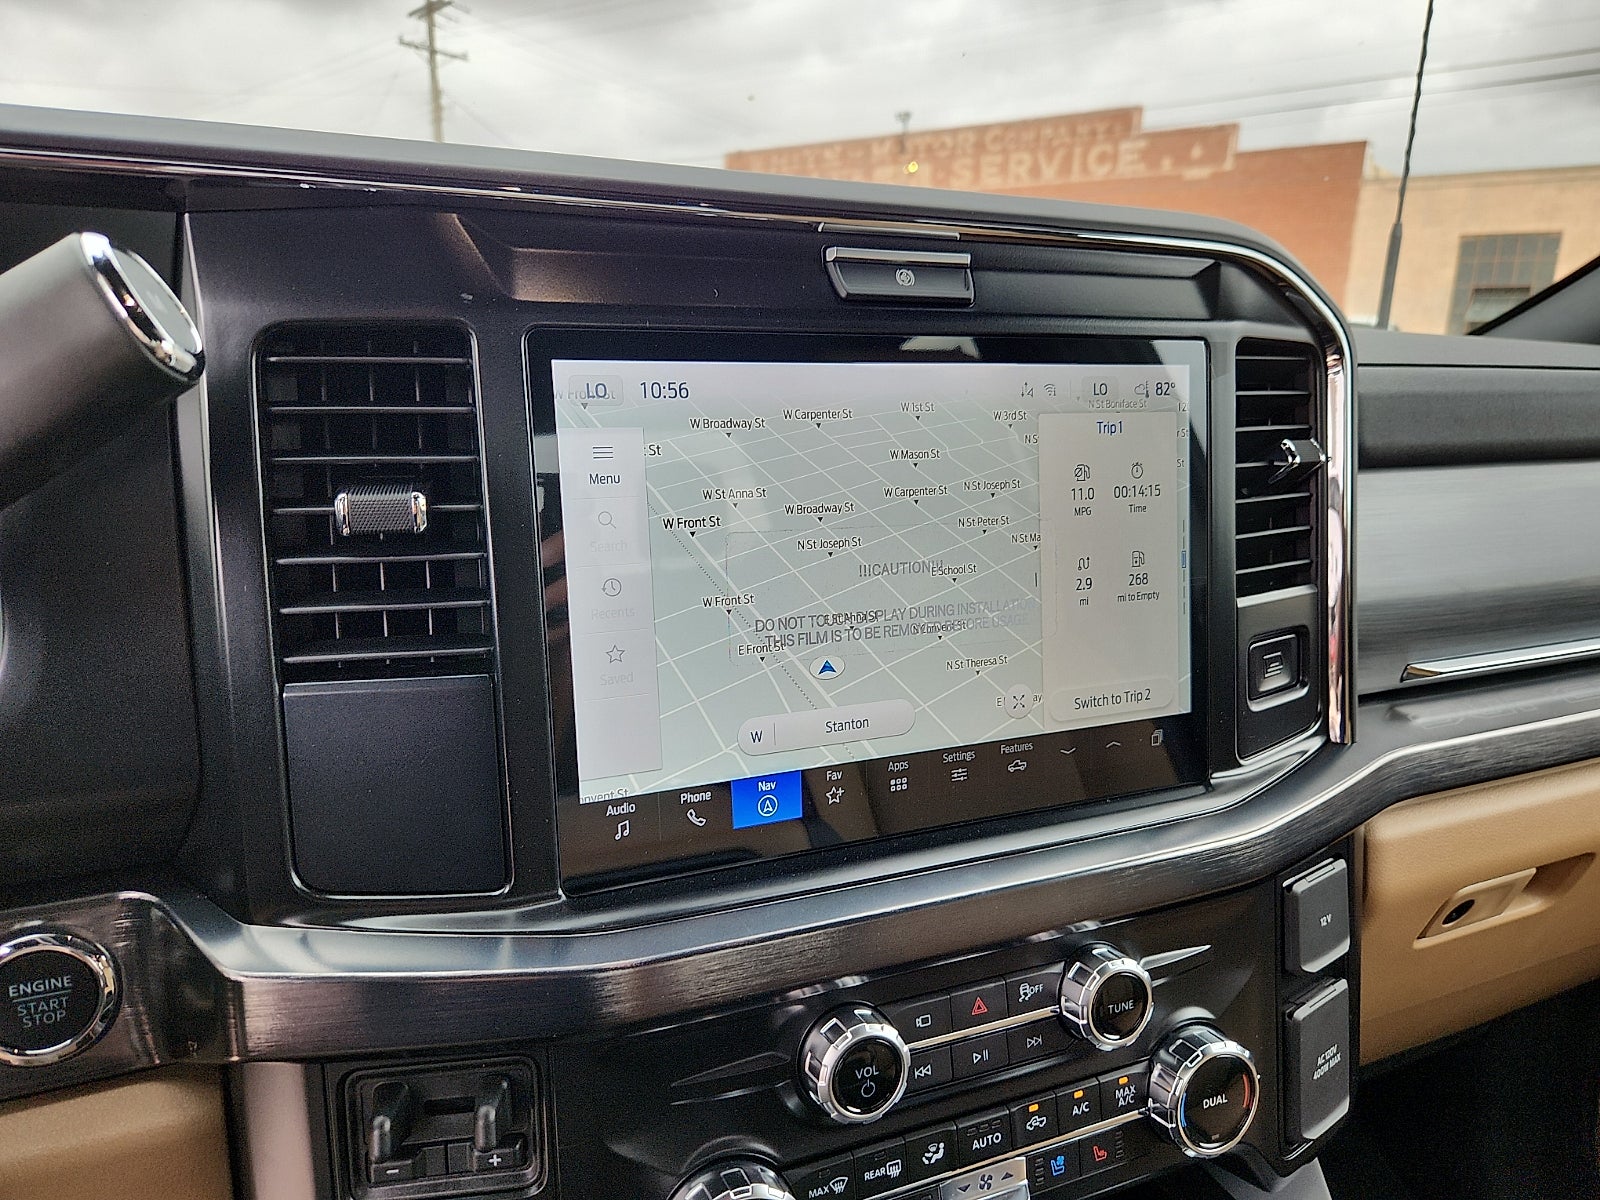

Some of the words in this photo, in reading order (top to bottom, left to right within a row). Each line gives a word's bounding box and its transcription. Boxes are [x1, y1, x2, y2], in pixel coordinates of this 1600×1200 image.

[950, 137, 1148, 189] SERVICE
[586, 382, 607, 399] LO
[640, 381, 689, 399] 10:56
[1093, 382, 1108, 396] LO
[901, 402, 911, 413] W
[911, 402, 923, 412] 1st
[925, 402, 935, 412] St
[1088, 401, 1096, 409] N
[1105, 400, 1138, 408] Boniface
[1138, 400, 1147, 408] St
[783, 409, 793, 419] W
[794, 409, 840, 421] Carpenter
[841, 409, 853, 419] St
[993, 411, 1003, 422] W
[1003, 410, 1016, 421] 3rd
[1017, 410, 1027, 421] St
[690, 418, 701, 429] W
[702, 417, 753, 431] Broadway
[754, 417, 766, 428] St
[1096, 421, 1116, 436] Trip
[1024, 435, 1032, 444] N
[648, 444, 662, 456] St
[889, 450, 899, 460] W
[900, 448, 930, 460] Mason
[930, 448, 940, 459] St
[1176, 459, 1185, 468] St
[589, 473, 621, 485] Menu
[963, 480, 971, 491] N
[971, 480, 982, 491] St
[982, 479, 1009, 493] Joseph
[1010, 479, 1021, 490] St
[702, 489, 713, 499] W
[714, 488, 726, 499] St
[728, 488, 754, 499] Anna
[755, 487, 767, 498] St
[884, 487, 893, 497] W
[894, 485, 937, 499] Carpenter
[938, 485, 948, 496] St
[1071, 487, 1095, 500] 11.0
[1113, 485, 1161, 499] 00:14:15
[784, 505, 795, 515] W
[796, 503, 843, 517] Broadway
[844, 502, 855, 513] St
[1074, 506, 1092, 517] MPG
[1128, 503, 1147, 514] Time
[662, 517, 676, 529] W
[677, 516, 705, 529] Front
[707, 515, 721, 528] St
[958, 518, 966, 528] N
[966, 517, 976, 527] St
[976, 516, 999, 527] Peter
[1000, 515, 1010, 526] St
[797, 540, 805, 550] N
[806, 539, 818, 550] St
[819, 538, 850, 552] Joseph
[851, 536, 862, 547] St
[1011, 534, 1018, 543] N
[1019, 533, 1029, 543] St
[590, 540, 628, 553] Search
[938, 564, 966, 576] School
[967, 563, 977, 573] St
[1076, 578, 1093, 591] 2.9
[1128, 573, 1149, 586] 268
[702, 597, 714, 608] W
[715, 595, 742, 607] Front
[743, 593, 755, 605] St
[1079, 596, 1089, 606] mi
[1117, 593, 1127, 603] mi
[1128, 592, 1136, 602] to
[1136, 590, 1160, 602] Empty
[591, 607, 637, 620] Recents
[755, 618, 775, 632] DO
[778, 615, 806, 630] NOT
[909, 604, 955, 619] DURING
[765, 633, 795, 648] THIS
[797, 630, 828, 646] FILM
[831, 629, 842, 643] IS
[845, 627, 862, 642] TO
[864, 625, 881, 639] BE
[738, 645, 745, 656] E
[746, 643, 772, 654] Front
[773, 641, 785, 652] St
[946, 661, 954, 671] N
[954, 659, 964, 670] St
[965, 657, 998, 668] Theresa
[998, 655, 1008, 665] St
[600, 672, 634, 685] Saved
[996, 697, 1002, 707] E
[1074, 692, 1109, 709] Switch
[1110, 693, 1122, 705] to
[1122, 690, 1143, 704] Trip
[1144, 688, 1151, 701] 2
[825, 717, 870, 734] Stanton
[750, 731, 763, 743] W
[1000, 741, 1034, 755] Features
[942, 750, 976, 764] Settings
[888, 760, 909, 772] Apps
[826, 769, 843, 781] Fav
[758, 781, 776, 792] Nav
[680, 790, 712, 804] Phone
[606, 802, 636, 816] Audio
[1320, 913, 1332, 927] 12V
[9, 976, 73, 997] ENGINE
[1029, 982, 1044, 995] OFF
[17, 996, 69, 1017] START
[1107, 999, 1135, 1015] TUNE
[22, 1010, 66, 1028] STOP
[855, 1066, 879, 1079] VOL
[1115, 1085, 1137, 1099] MAX
[1118, 1094, 1135, 1107] A/C
[1203, 1094, 1228, 1109] DUAL
[1072, 1101, 1090, 1116] A/C
[972, 1132, 1002, 1150] AUTO
[864, 1166, 886, 1181] REAR
[808, 1186, 830, 1198] MAX
